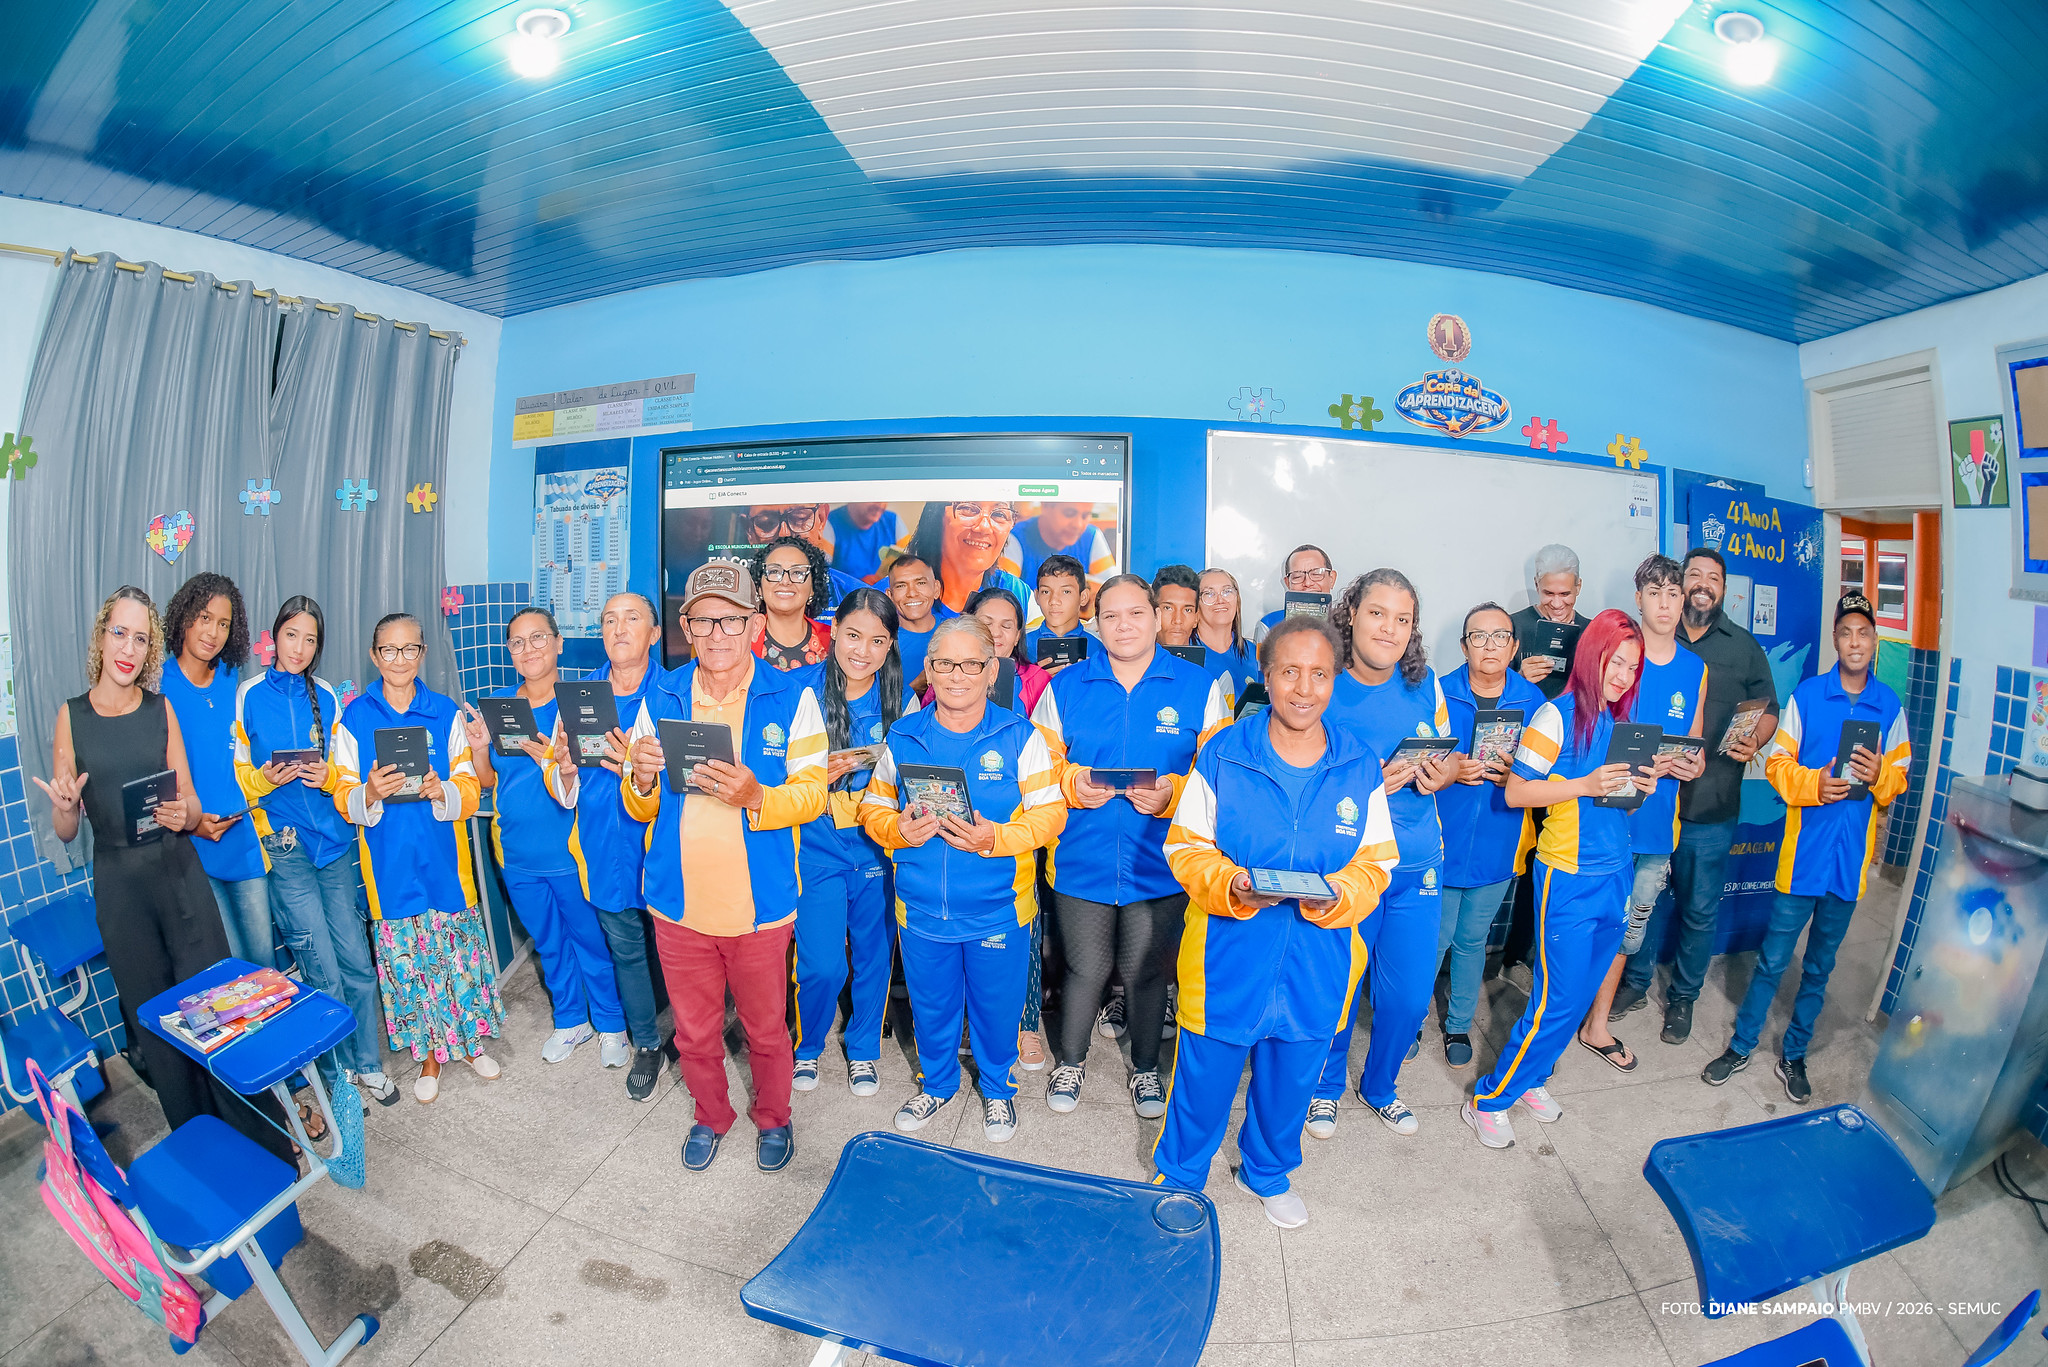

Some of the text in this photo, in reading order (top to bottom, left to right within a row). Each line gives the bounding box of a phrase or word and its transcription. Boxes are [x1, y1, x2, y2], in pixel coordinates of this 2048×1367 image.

[560, 392, 584, 404] Valor
[598, 389, 606, 399] de
[654, 381, 676, 394] QVL
[1427, 379, 1478, 398] Copa da
[1404, 393, 1501, 419] APRENDIZAGEM
[550, 504, 572, 512] Tabuada
